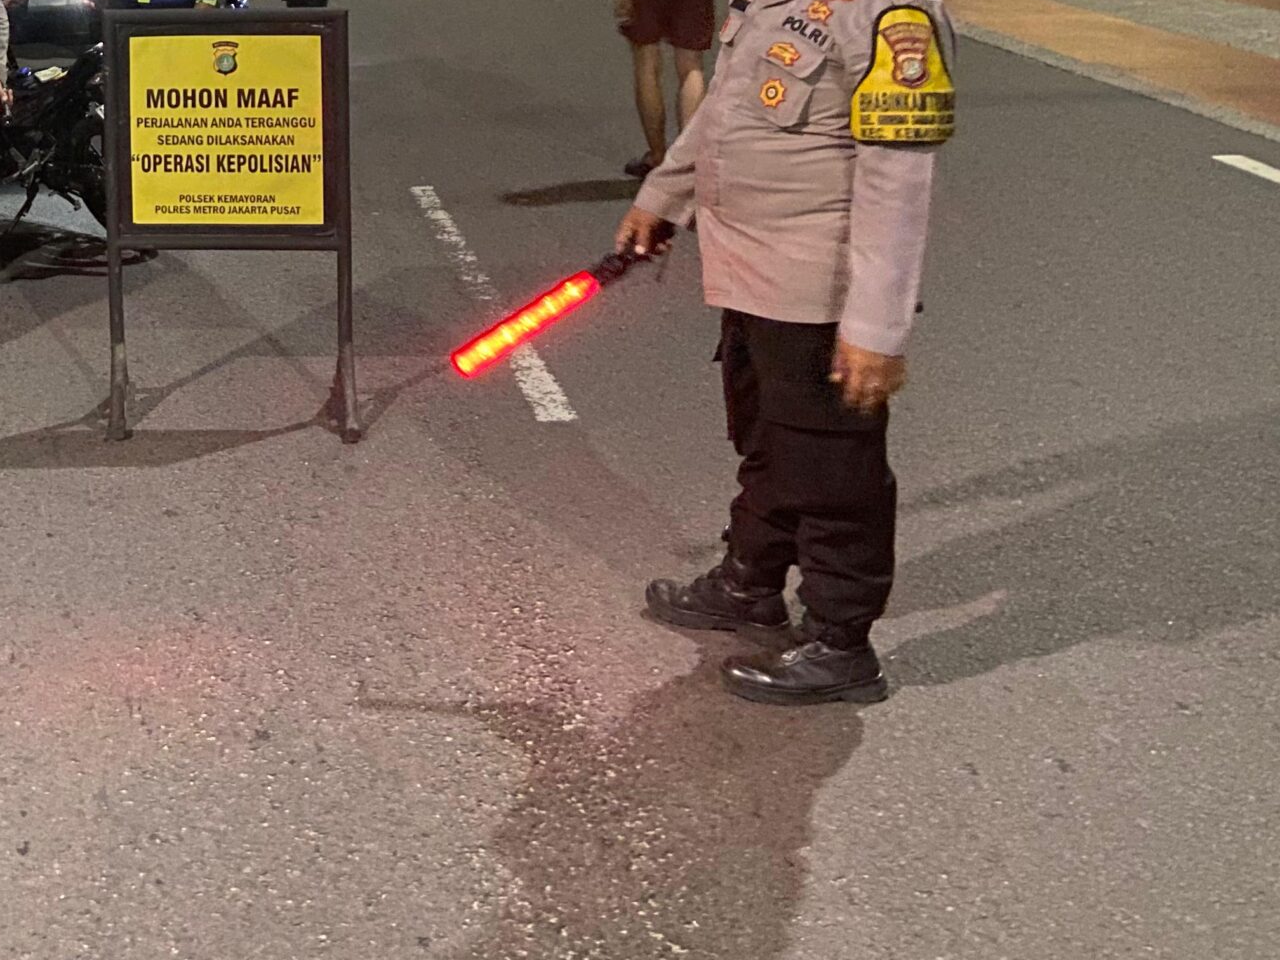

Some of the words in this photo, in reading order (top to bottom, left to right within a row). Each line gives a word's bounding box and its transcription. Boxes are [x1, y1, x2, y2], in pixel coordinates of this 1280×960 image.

[782, 16, 829, 47] POLRI
[146, 88, 228, 109] MOHON
[236, 88, 299, 108] MAAF
[136, 117, 208, 128] PERJALANAN
[210, 117, 242, 128] ANDA
[245, 117, 316, 128] TERGANGGU
[157, 135, 203, 146] SEDANG
[207, 135, 295, 146] DILAKSANAKAN
[179, 195, 215, 203] POLSEK
[217, 195, 276, 203] KEMAYORAN
[155, 206, 191, 214] POLRES
[193, 206, 226, 214] METRO
[228, 206, 268, 214] JAKARTA
[270, 206, 301, 215] PUSAT
